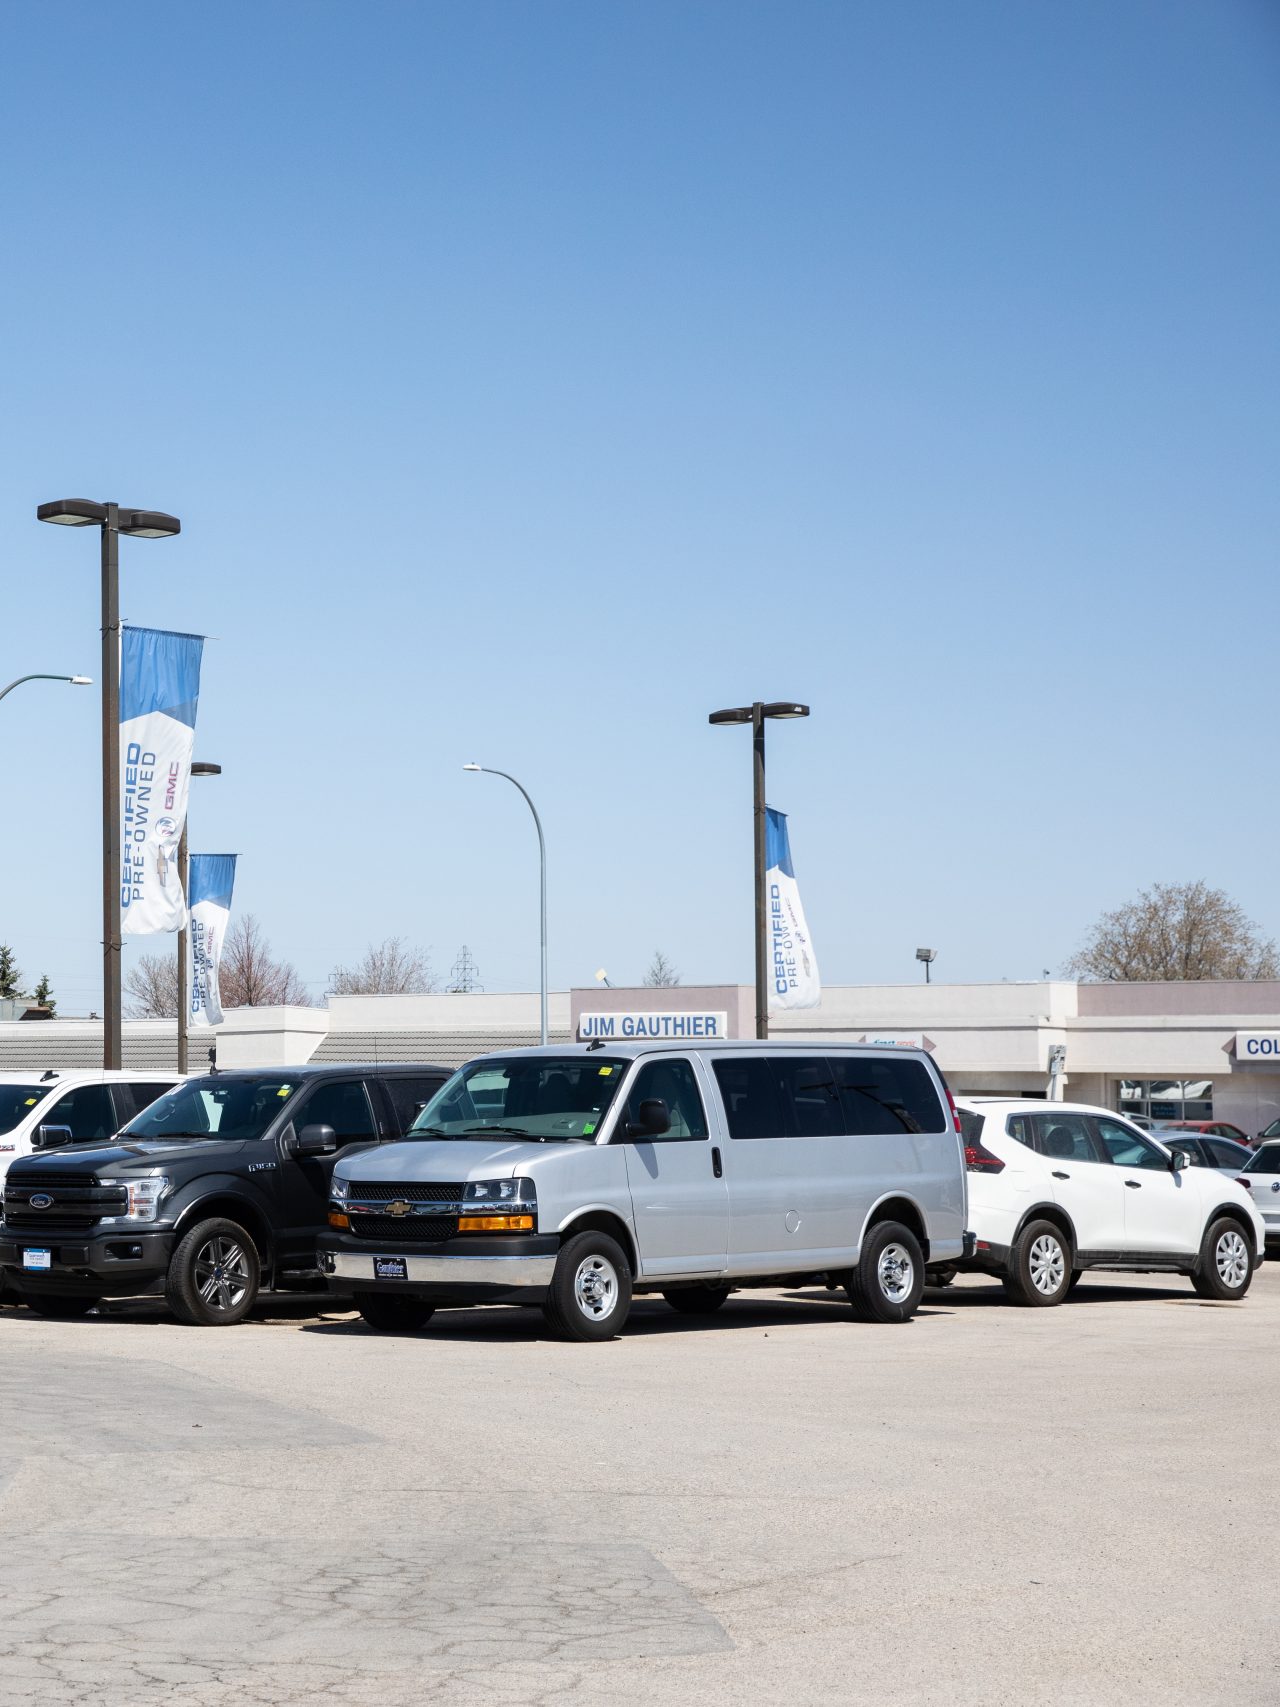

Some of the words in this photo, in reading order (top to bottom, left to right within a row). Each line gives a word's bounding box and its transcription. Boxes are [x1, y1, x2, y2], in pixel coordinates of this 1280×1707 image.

[121, 743, 140, 908] CERTIFIED
[132, 752, 156, 900] PRE-OWNED
[164, 762, 179, 810] GMC
[192, 919, 200, 1013] CERTIFIED
[198, 923, 207, 1008] PRE-OWNED
[770, 884, 788, 994] CERTIFIED
[583, 1017, 615, 1036] JIM
[622, 1016, 717, 1036] GAUTHIER
